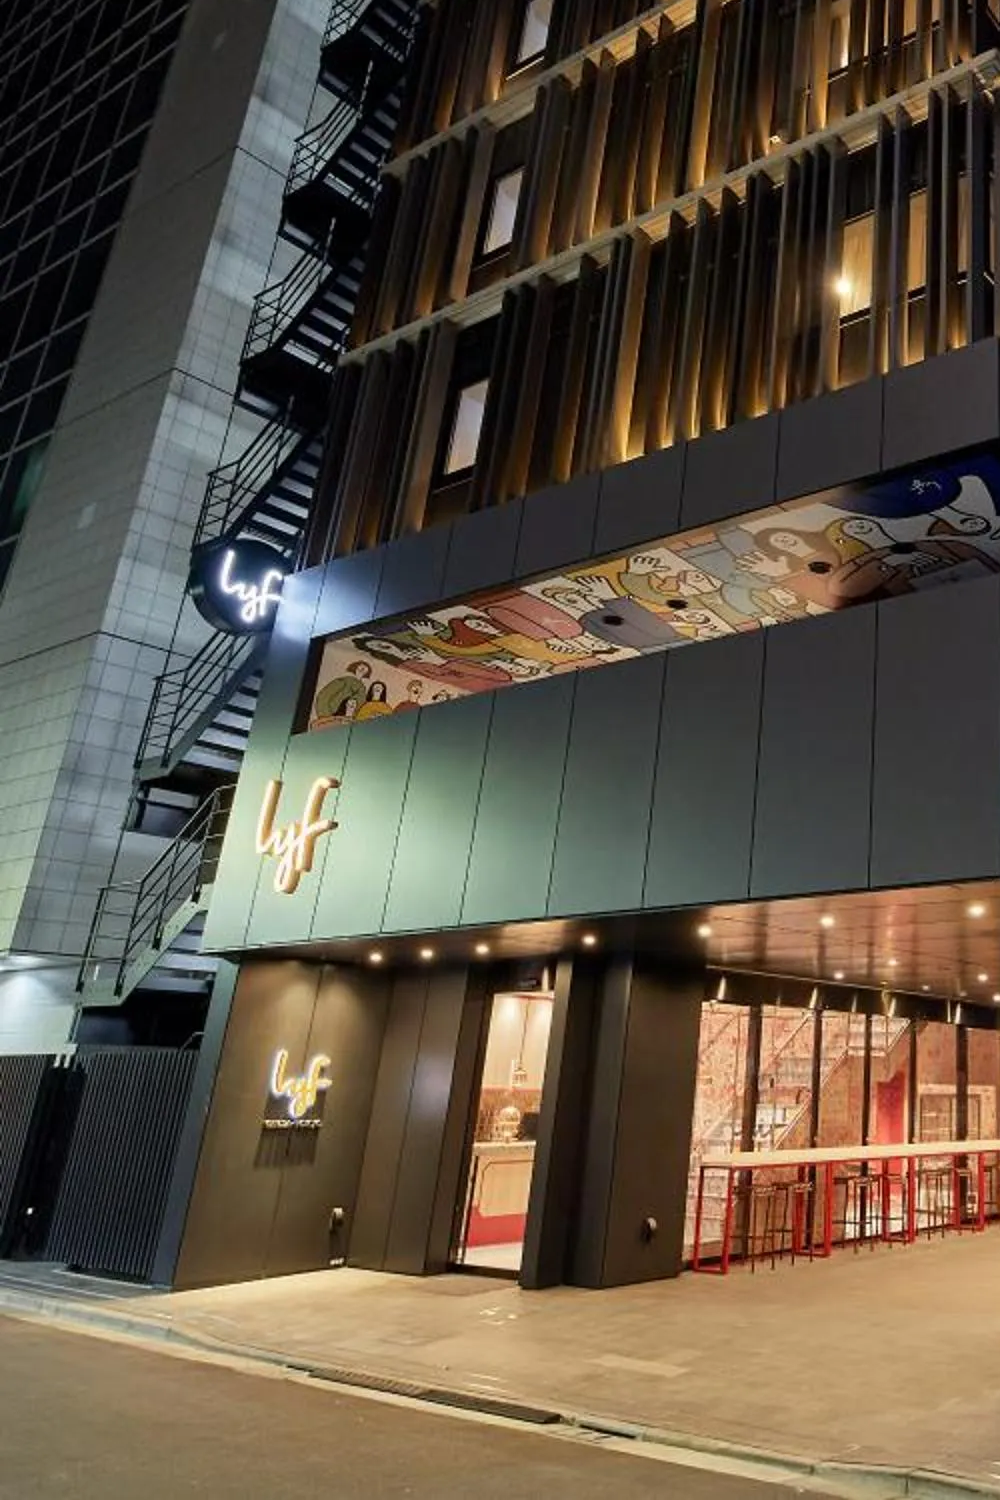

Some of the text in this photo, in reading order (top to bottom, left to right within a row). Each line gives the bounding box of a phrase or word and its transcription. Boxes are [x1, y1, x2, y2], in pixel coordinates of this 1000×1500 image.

[218, 548, 285, 624] lyf
[255, 776, 342, 895] lyf
[271, 1048, 333, 1118] lyf
